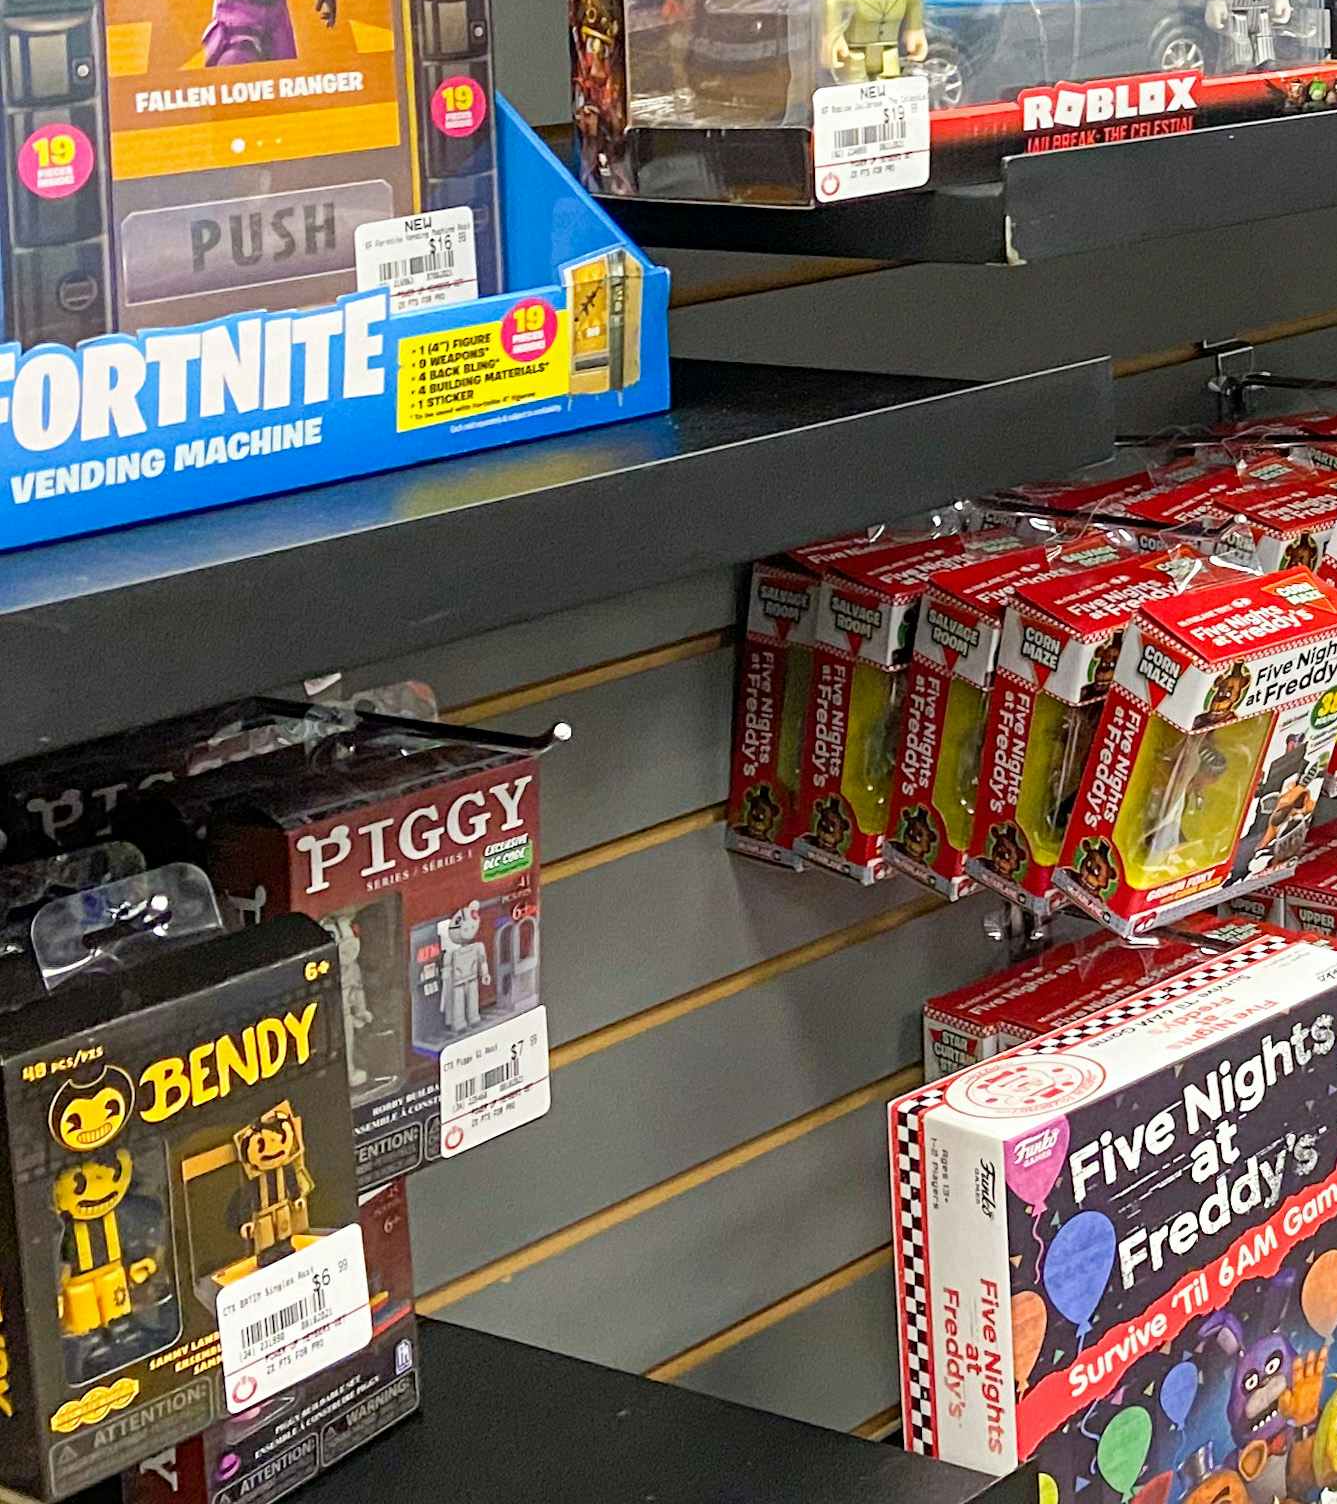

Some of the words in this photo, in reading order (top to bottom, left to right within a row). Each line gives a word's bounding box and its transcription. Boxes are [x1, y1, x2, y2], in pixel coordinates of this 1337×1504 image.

[135, 87, 215, 112] FALLEN
[220, 79, 274, 105] LOVE
[279, 71, 364, 96] RANGER
[440, 85, 472, 112] 19
[1023, 76, 1198, 132] ROBLOX
[32, 137, 76, 166] 19
[190, 200, 336, 275] PUSH
[405, 217, 432, 232] NEW
[512, 305, 545, 331] 19
[419, 346, 425, 355] 1
[453, 333, 491, 349] FIGURE
[418, 385, 426, 394] 4
[429, 375, 481, 394] BUILDING
[419, 371, 427, 381] 4
[430, 364, 459, 381] BACK
[427, 390, 474, 408] STICKER
[11, 453, 165, 503] VENDING
[174, 421, 321, 472] MACHINE
[831, 596, 882, 629] SALVAGE
[836, 613, 872, 640] ROOM
[928, 609, 980, 645] SALVAGE
[932, 627, 969, 656] ROOM
[1023, 626, 1062, 656] CORN
[1020, 642, 1059, 671] MAZE
[1144, 645, 1181, 678] CORN
[1138, 662, 1176, 695] MAZE
[1256, 661, 1294, 687] Five
[1246, 693, 1261, 707] at
[295, 774, 532, 896] PIGGY
[483, 833, 529, 857] EXCLUSIVE
[503, 846, 529, 865] CODE
[139, 1002, 318, 1123] BENDY
[1012, 1126, 1059, 1163] Funko
[1190, 1119, 1240, 1183] at
[1117, 1132, 1319, 1291] Freddy's
[312, 1268, 331, 1290] $6
[1069, 1310, 1167, 1397] Survive
[346, 1382, 412, 1427] WARNING:
